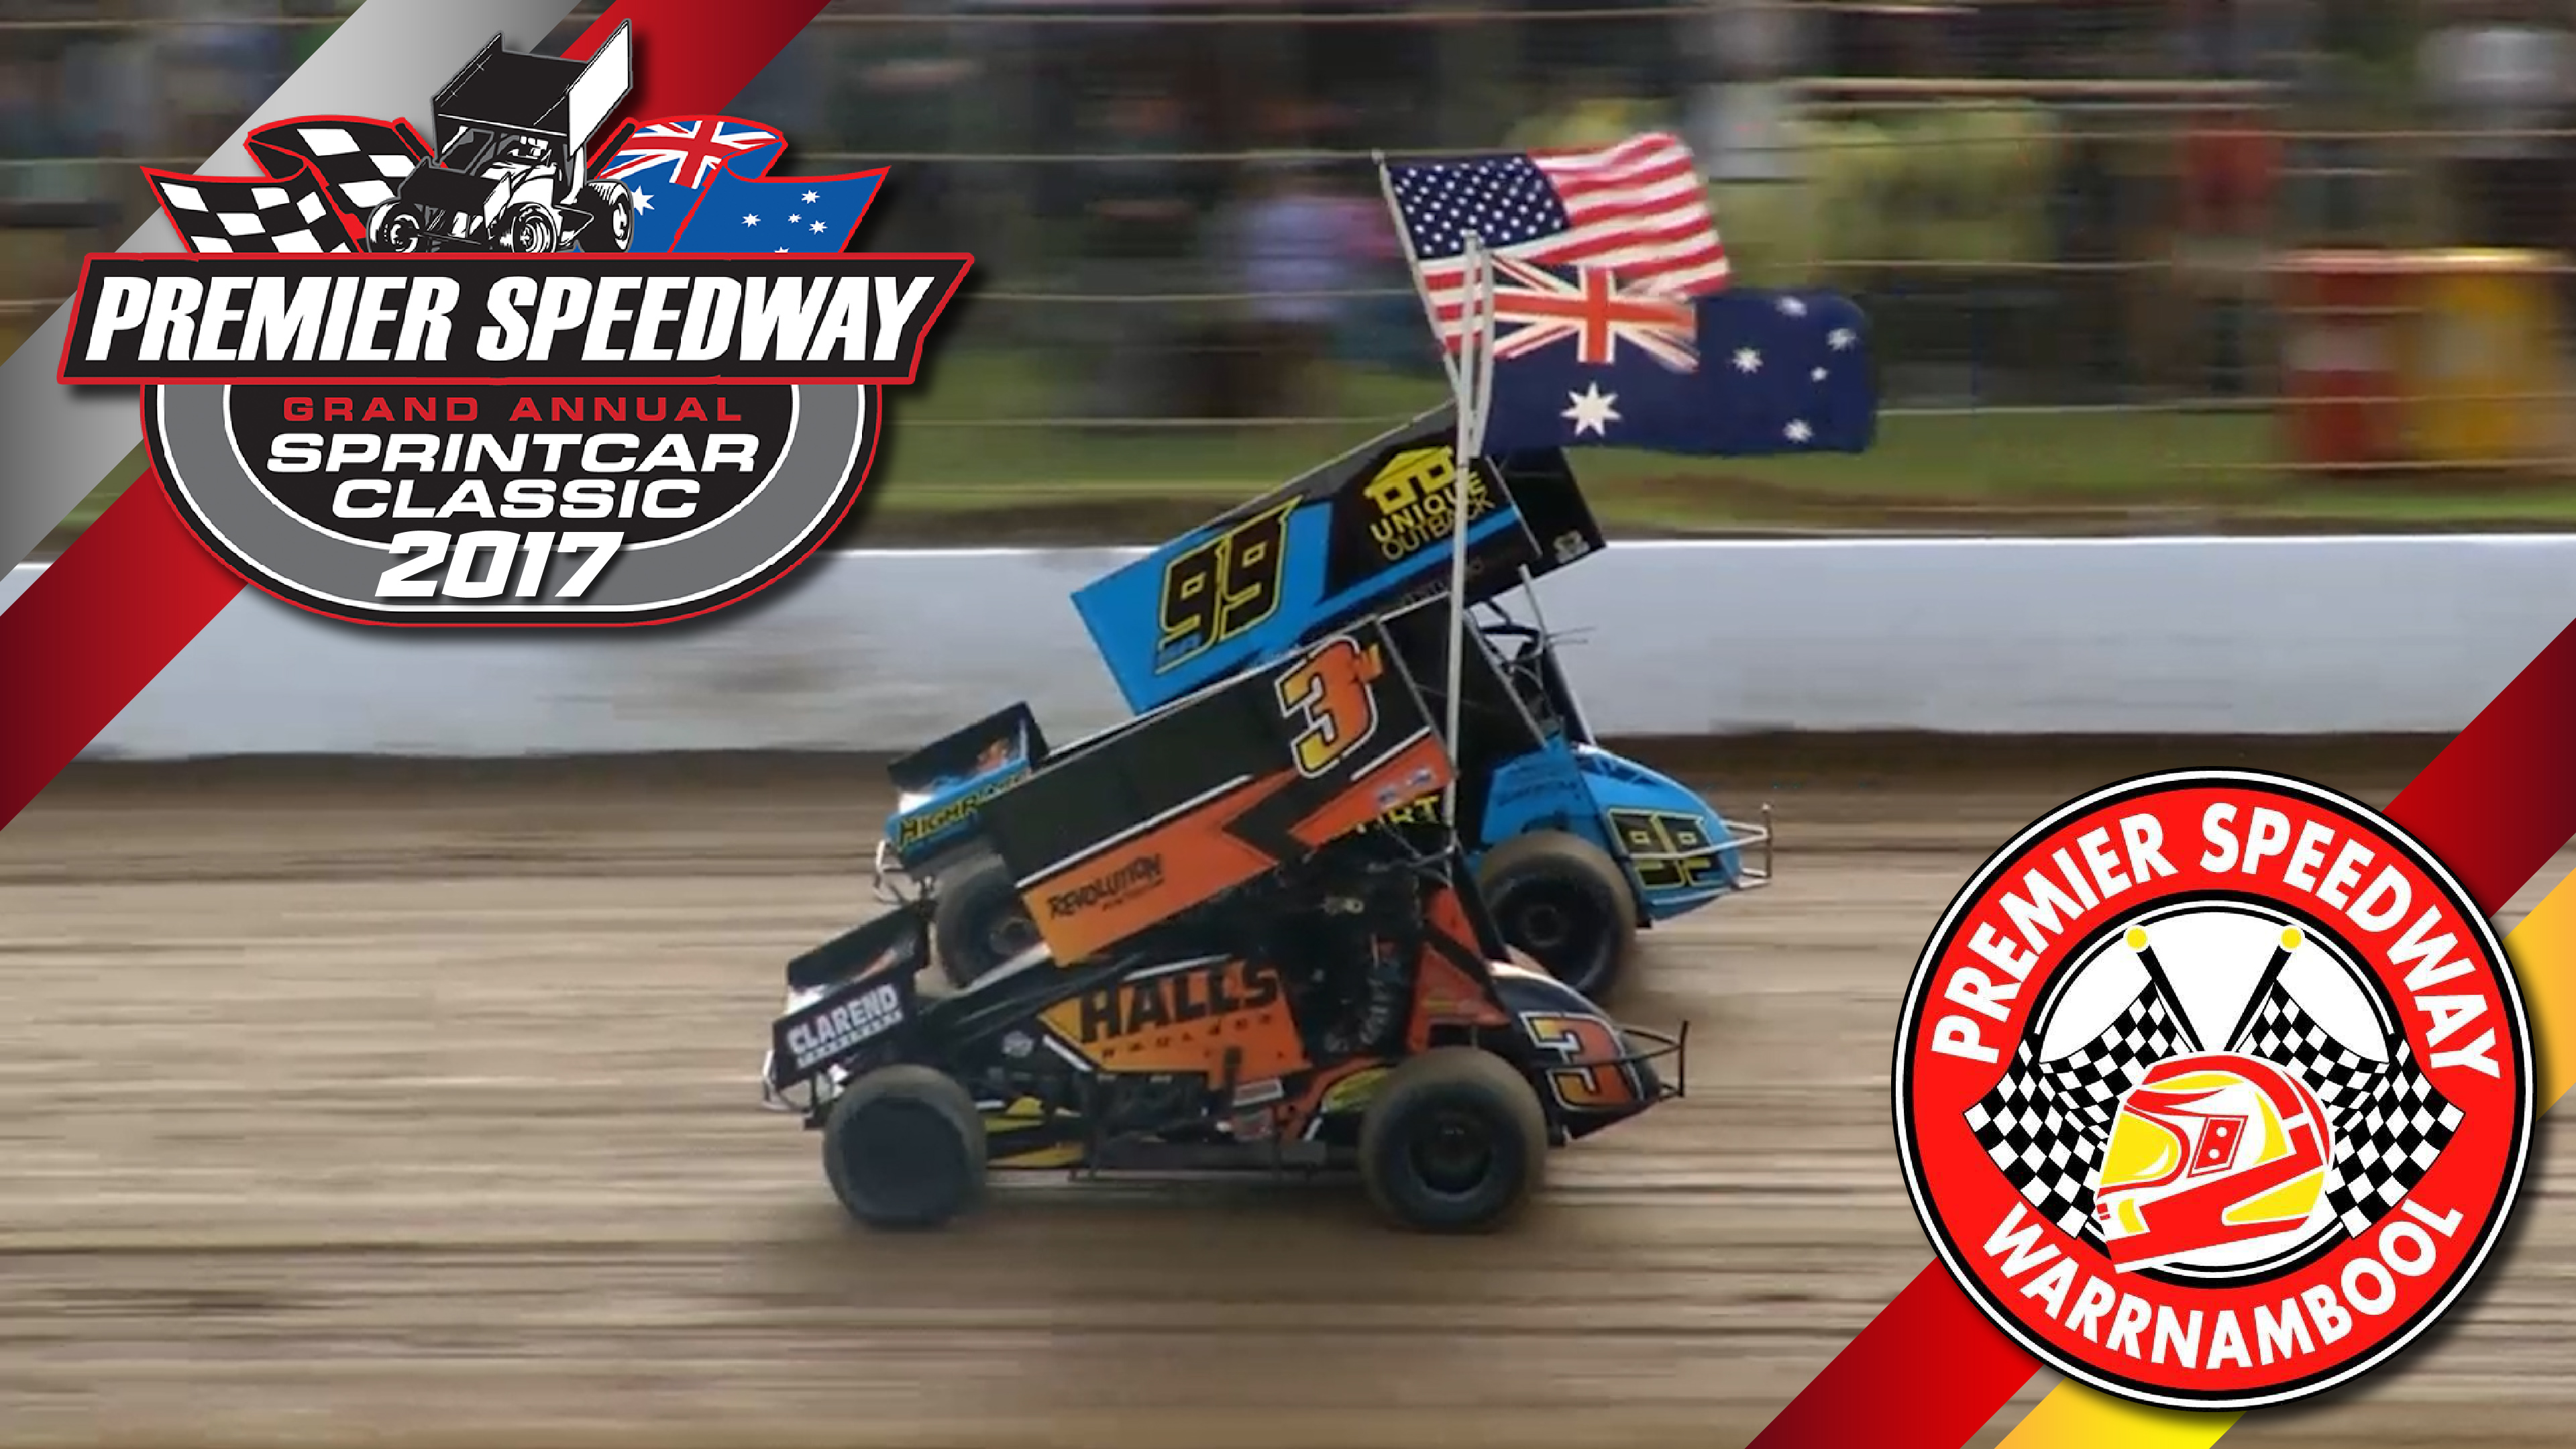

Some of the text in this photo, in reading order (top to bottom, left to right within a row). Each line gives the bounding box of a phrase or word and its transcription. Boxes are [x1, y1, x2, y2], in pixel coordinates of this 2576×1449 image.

[1153, 494, 1303, 675] 99
[1273, 635, 1379, 780] 3
[1080, 963, 1279, 1043] HALLS
[1518, 1012, 1645, 1112] 3
